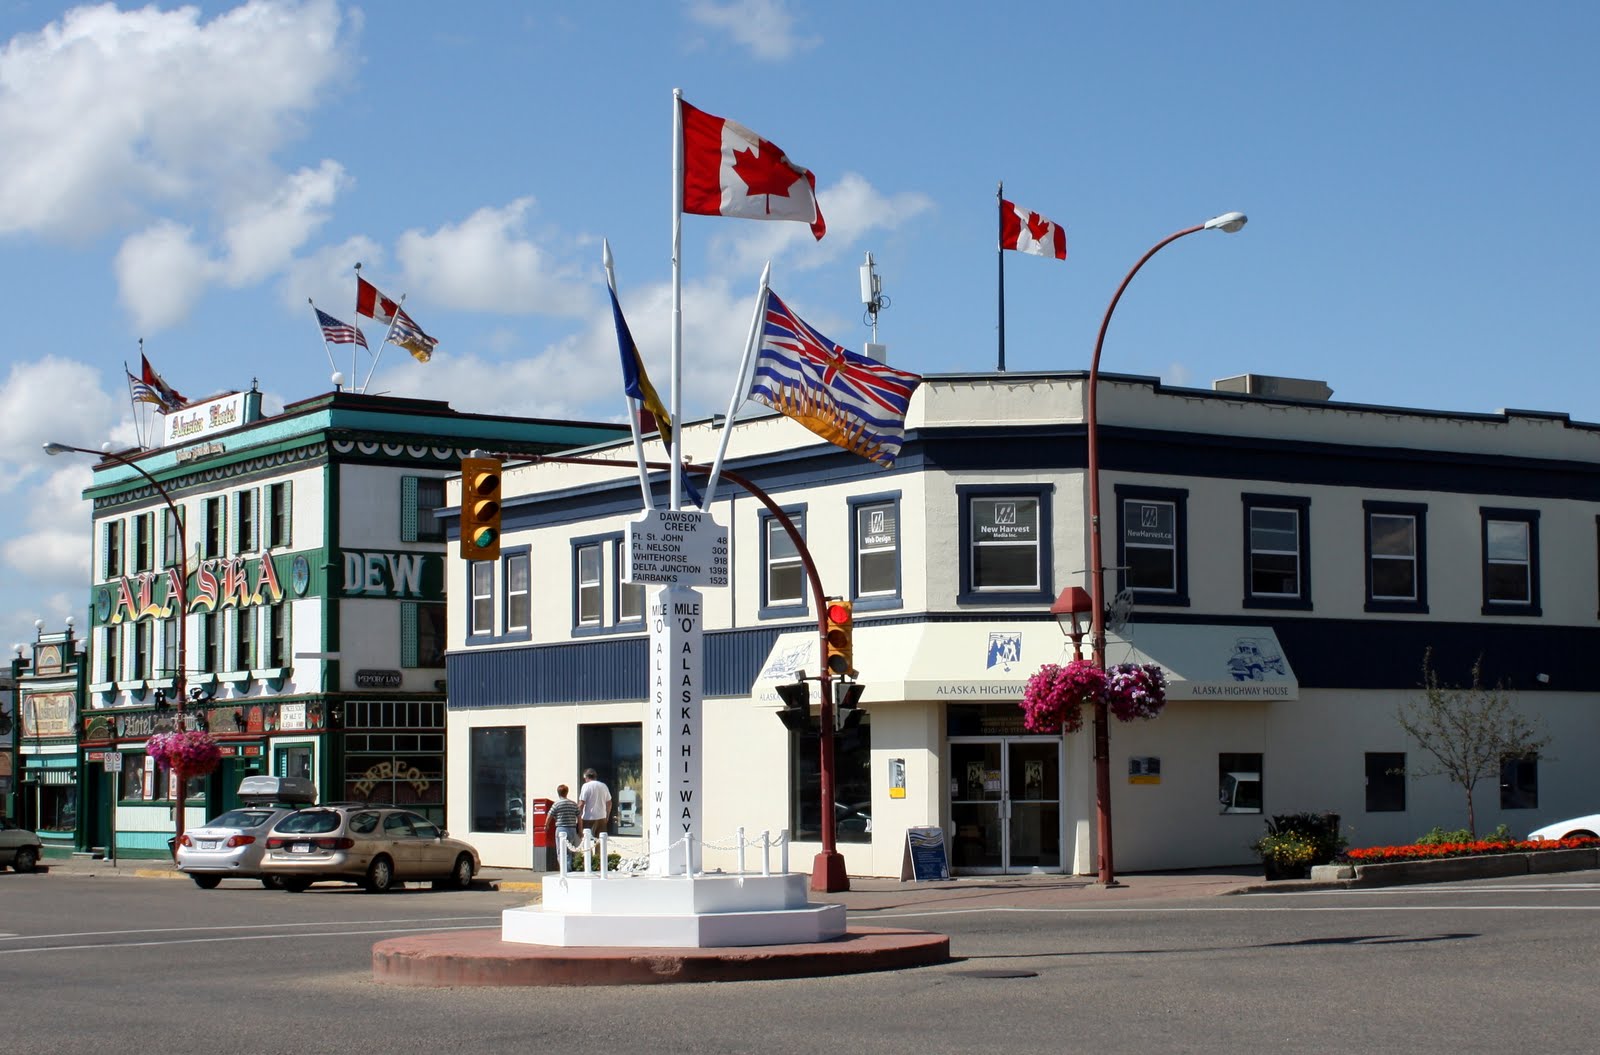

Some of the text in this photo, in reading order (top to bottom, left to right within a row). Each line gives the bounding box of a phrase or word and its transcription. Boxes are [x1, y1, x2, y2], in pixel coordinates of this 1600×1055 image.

[660, 512, 702, 522] DAWSON
[664, 522, 696, 532] CREEK
[660, 534, 684, 542] JOHN
[865, 534, 891, 544] Web Design
[1128, 530, 1172, 539] NewHarvest.ca
[646, 544, 680, 552] NELSON
[634, 553, 687, 562] WHITEHORSE
[632, 563, 657, 571] DELTA
[660, 565, 701, 574] JUNCTION
[342, 552, 426, 597] DEW
[632, 574, 678, 582] FAIRBANKS
[112, 551, 286, 624] ALASKA
[652, 604, 667, 616] MILE
[674, 603, 699, 616] MILE
[936, 686, 976, 694] ALASKA
[1192, 686, 1288, 695] ALASKA HIGHWAY HOUSE
[760, 693, 780, 701] ALASKA
[680, 641, 692, 832] ALASKA HI-WAY
[353, 761, 430, 799] PARLOR
